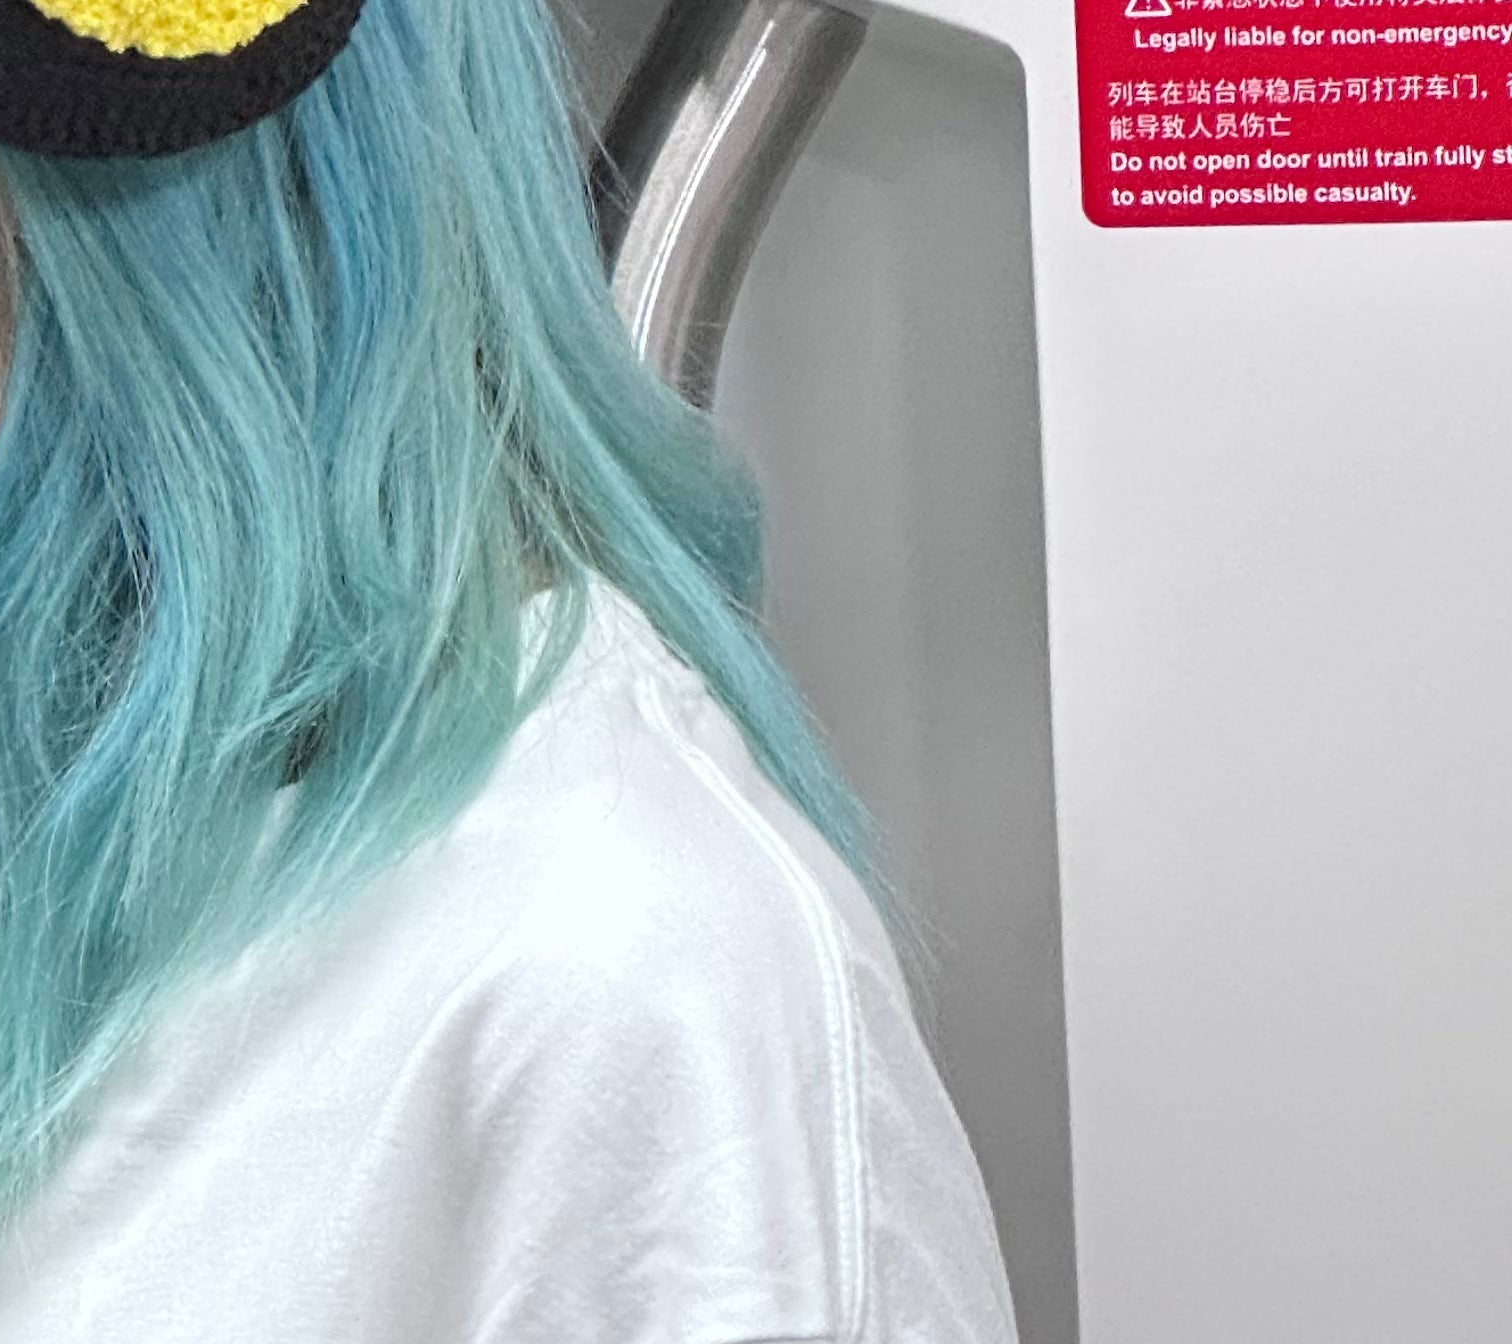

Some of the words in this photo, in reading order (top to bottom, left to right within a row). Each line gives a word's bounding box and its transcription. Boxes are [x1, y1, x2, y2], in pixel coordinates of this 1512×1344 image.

[1134, 27, 1217, 52] Legally
[1224, 25, 1286, 46] liable
[1292, 25, 1325, 46] for
[1331, 23, 1512, 47] non-emergency
[1109, 112, 1292, 141] 能导致人员伤亡
[1110, 152, 1142, 171] Do
[1149, 152, 1187, 171] not
[1193, 153, 1250, 174] open
[1257, 149, 1311, 169] door
[1317, 147, 1368, 168] until
[1375, 146, 1428, 167] train
[1435, 145, 1486, 170] fully
[1111, 187, 1135, 206] to
[1141, 185, 1203, 205] avoid
[1211, 183, 1308, 208] possible
[1314, 181, 1417, 205] casualty.
